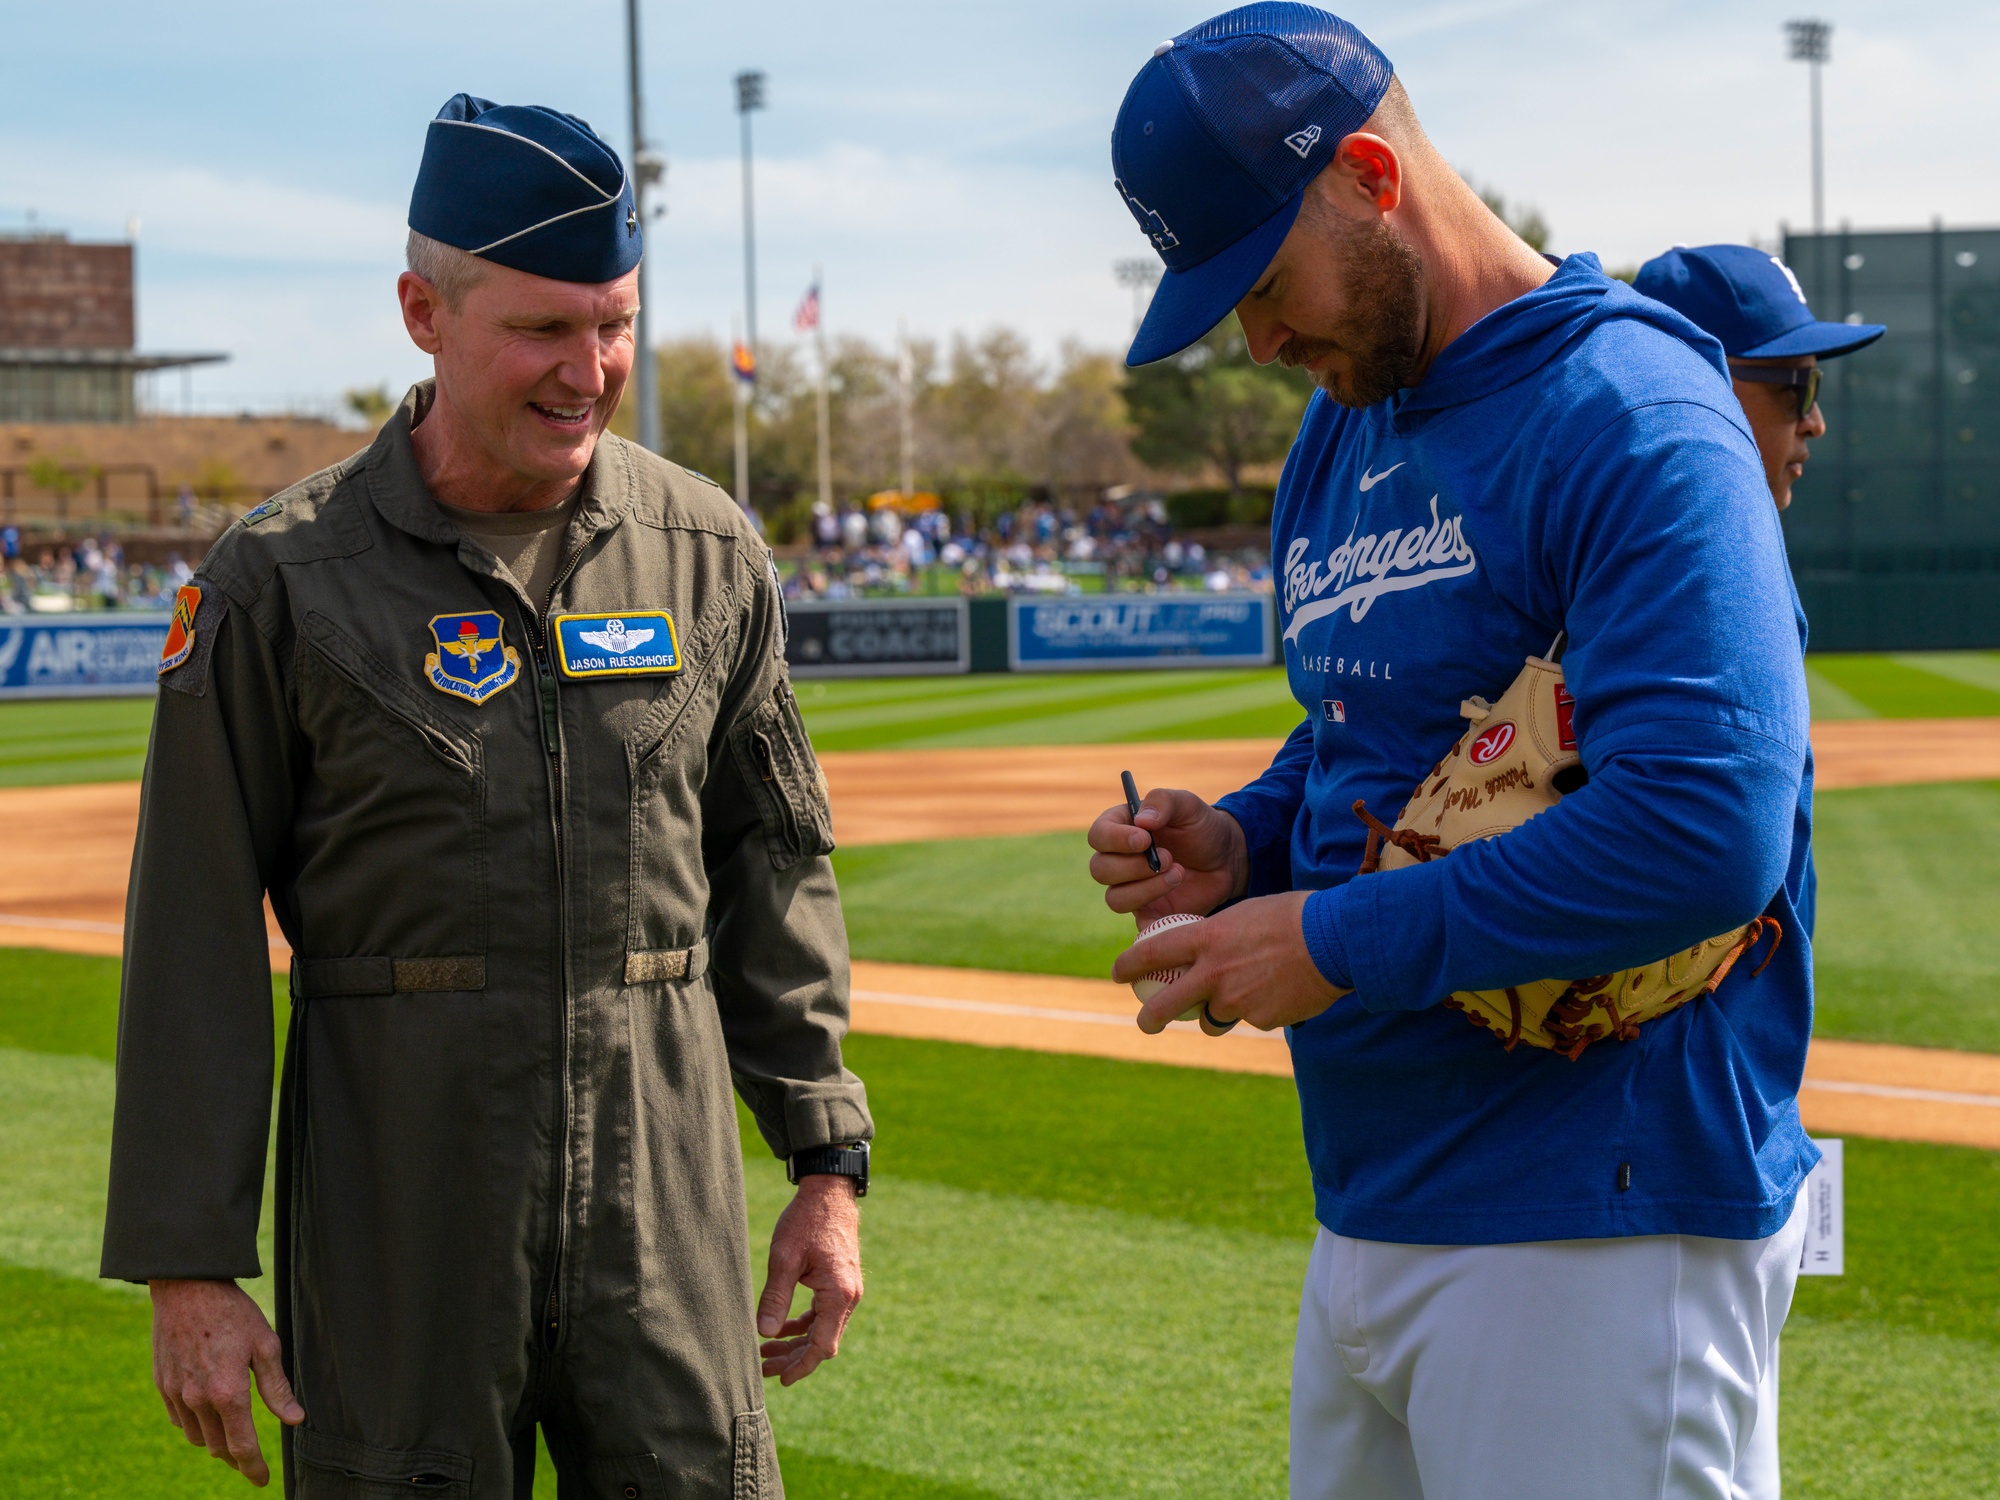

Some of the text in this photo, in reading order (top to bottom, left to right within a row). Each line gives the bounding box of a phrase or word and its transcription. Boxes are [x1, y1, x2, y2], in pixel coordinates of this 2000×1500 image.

[1284, 494, 1476, 623] Los Angeles
[174, 647, 188, 663] WING
[570, 655, 674, 670] JASON RUESCHHOFF
[432, 668, 443, 682] AIR
[439, 678, 471, 695] EDUCATION
[469, 688, 476, 697] &
[1485, 761, 1534, 802] Patrick
